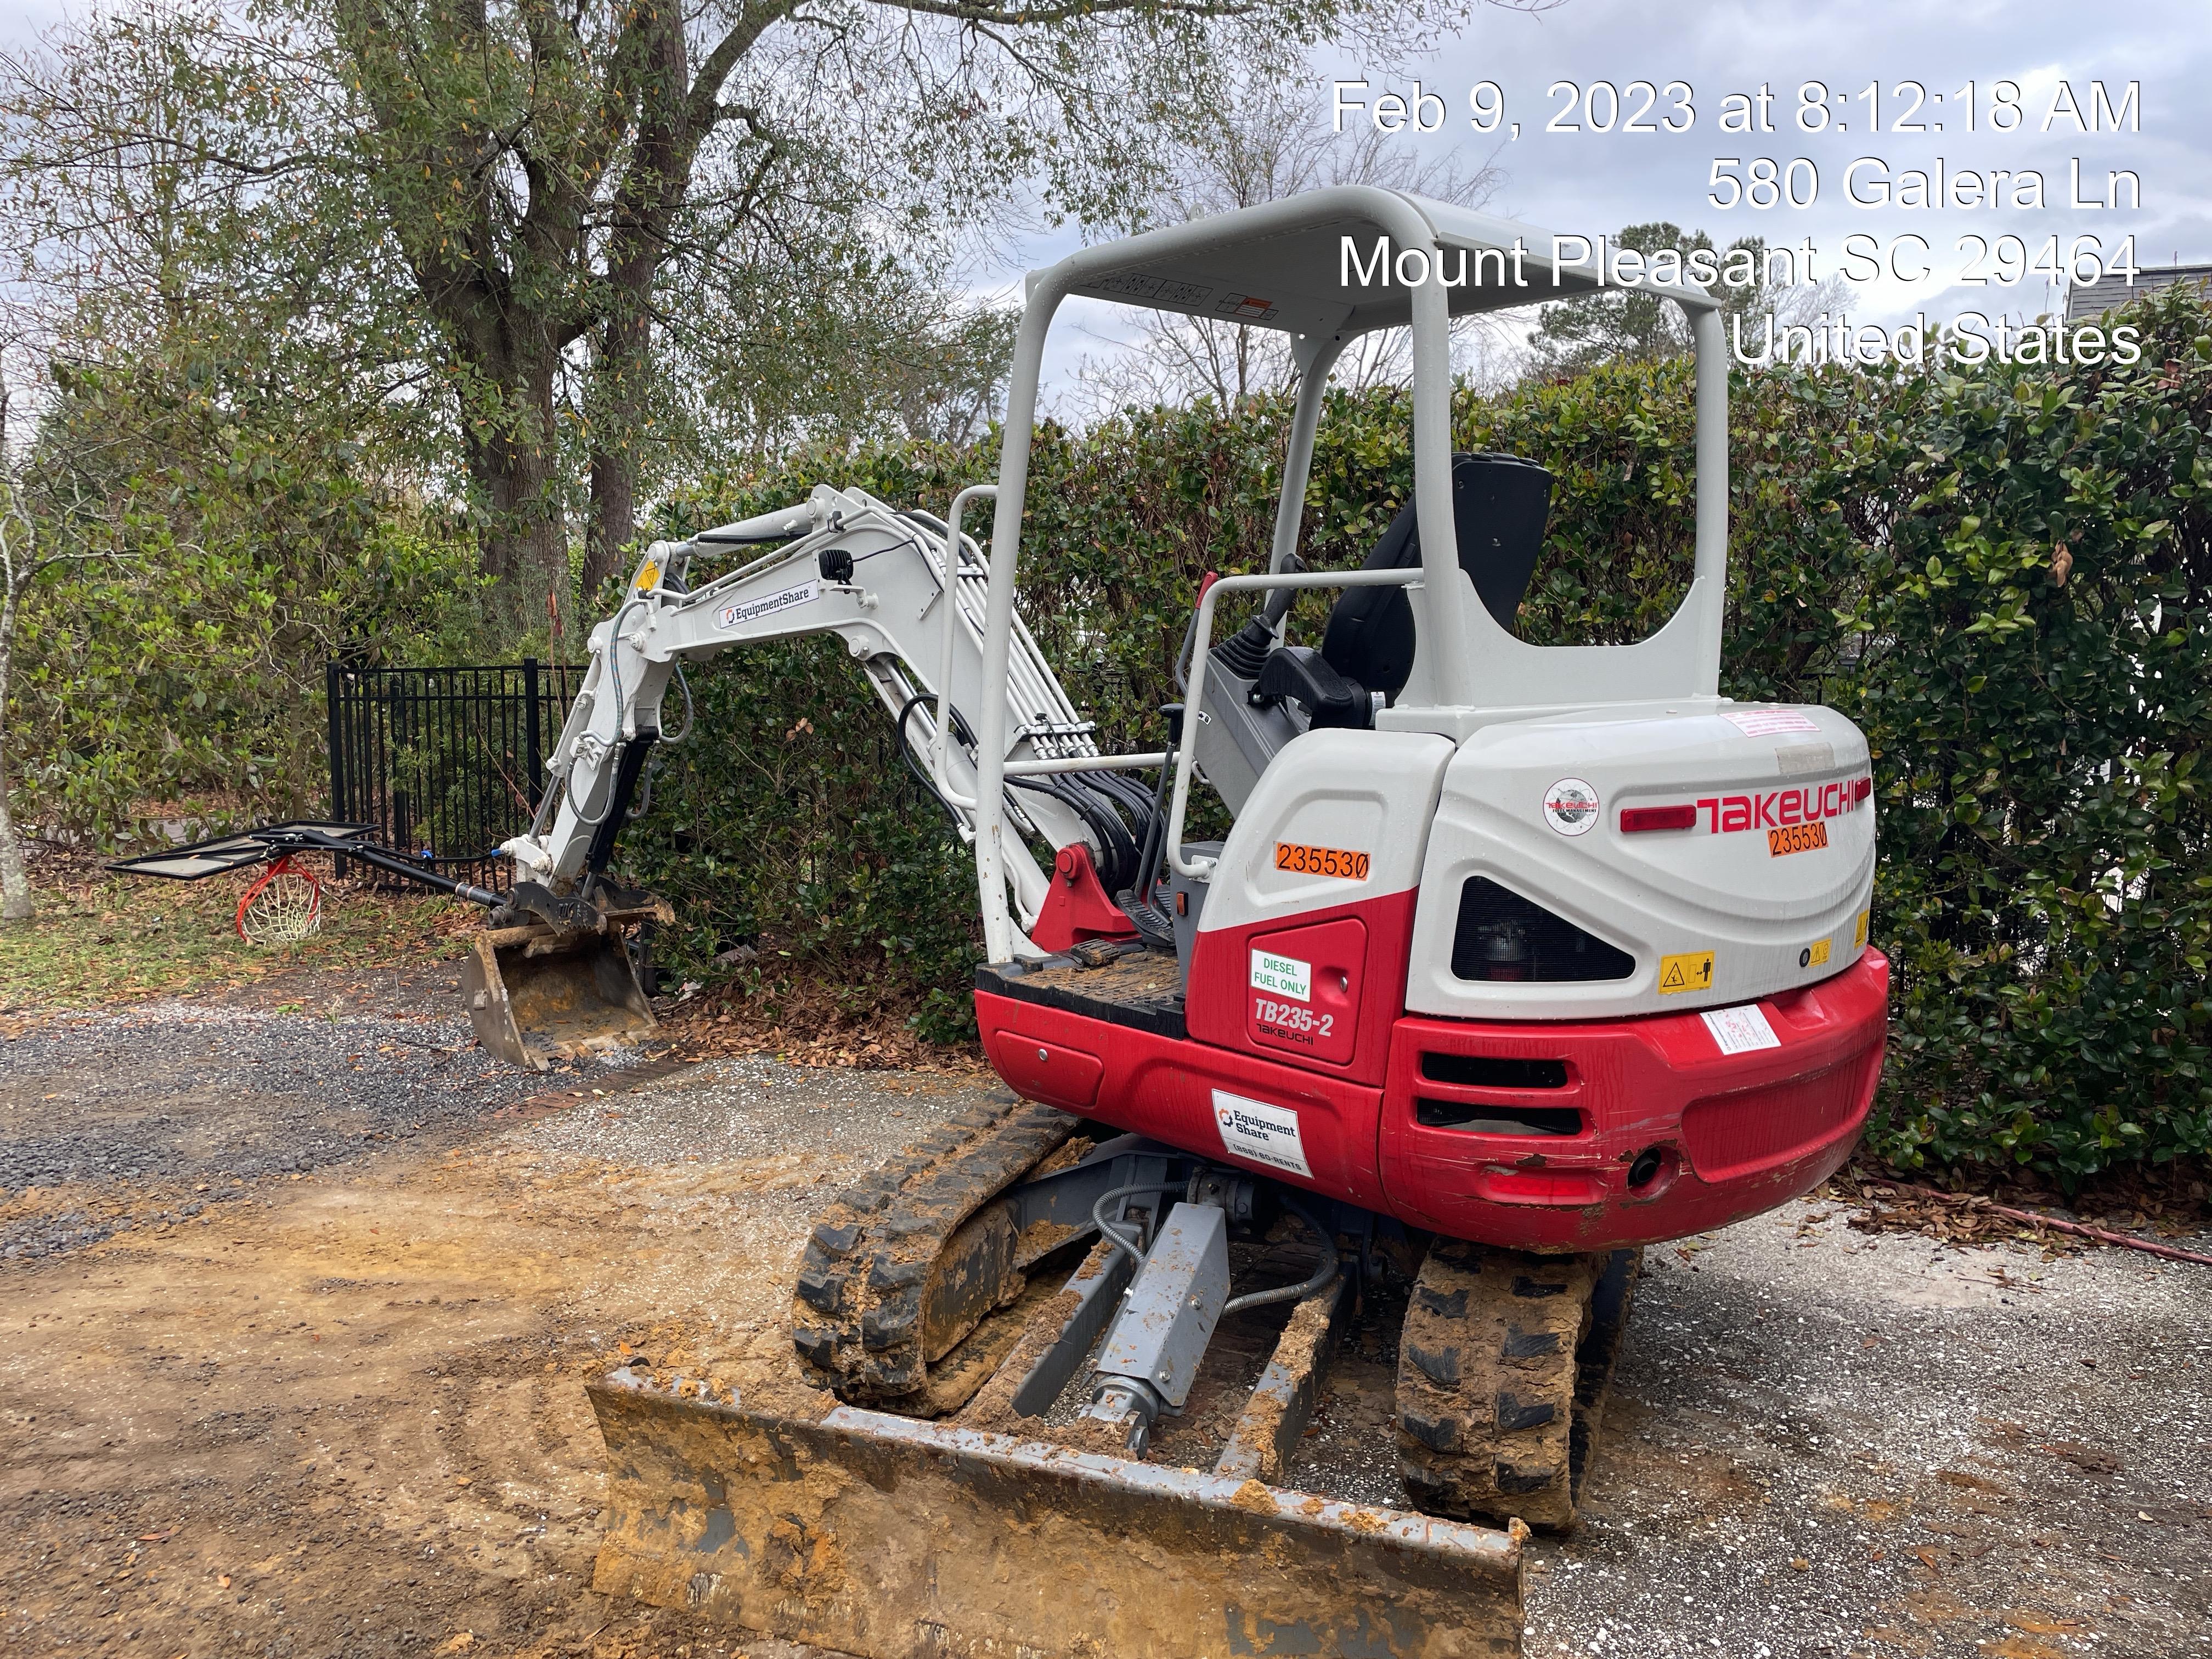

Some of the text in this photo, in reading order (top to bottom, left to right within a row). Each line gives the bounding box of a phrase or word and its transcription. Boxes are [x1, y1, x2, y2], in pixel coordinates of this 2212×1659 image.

[736, 588, 809, 620] EquipmentShare
[1771, 822, 1827, 856] 235530
[1278, 844, 1369, 879] 235530
[1263, 957, 1297, 977] DIESEL
[1254, 972, 1307, 996] FUEL ONLY
[1255, 998, 1334, 1037] TB235-2
[1233, 1109, 1296, 1137] Equipment
[1236, 1122, 1269, 1141] Share
